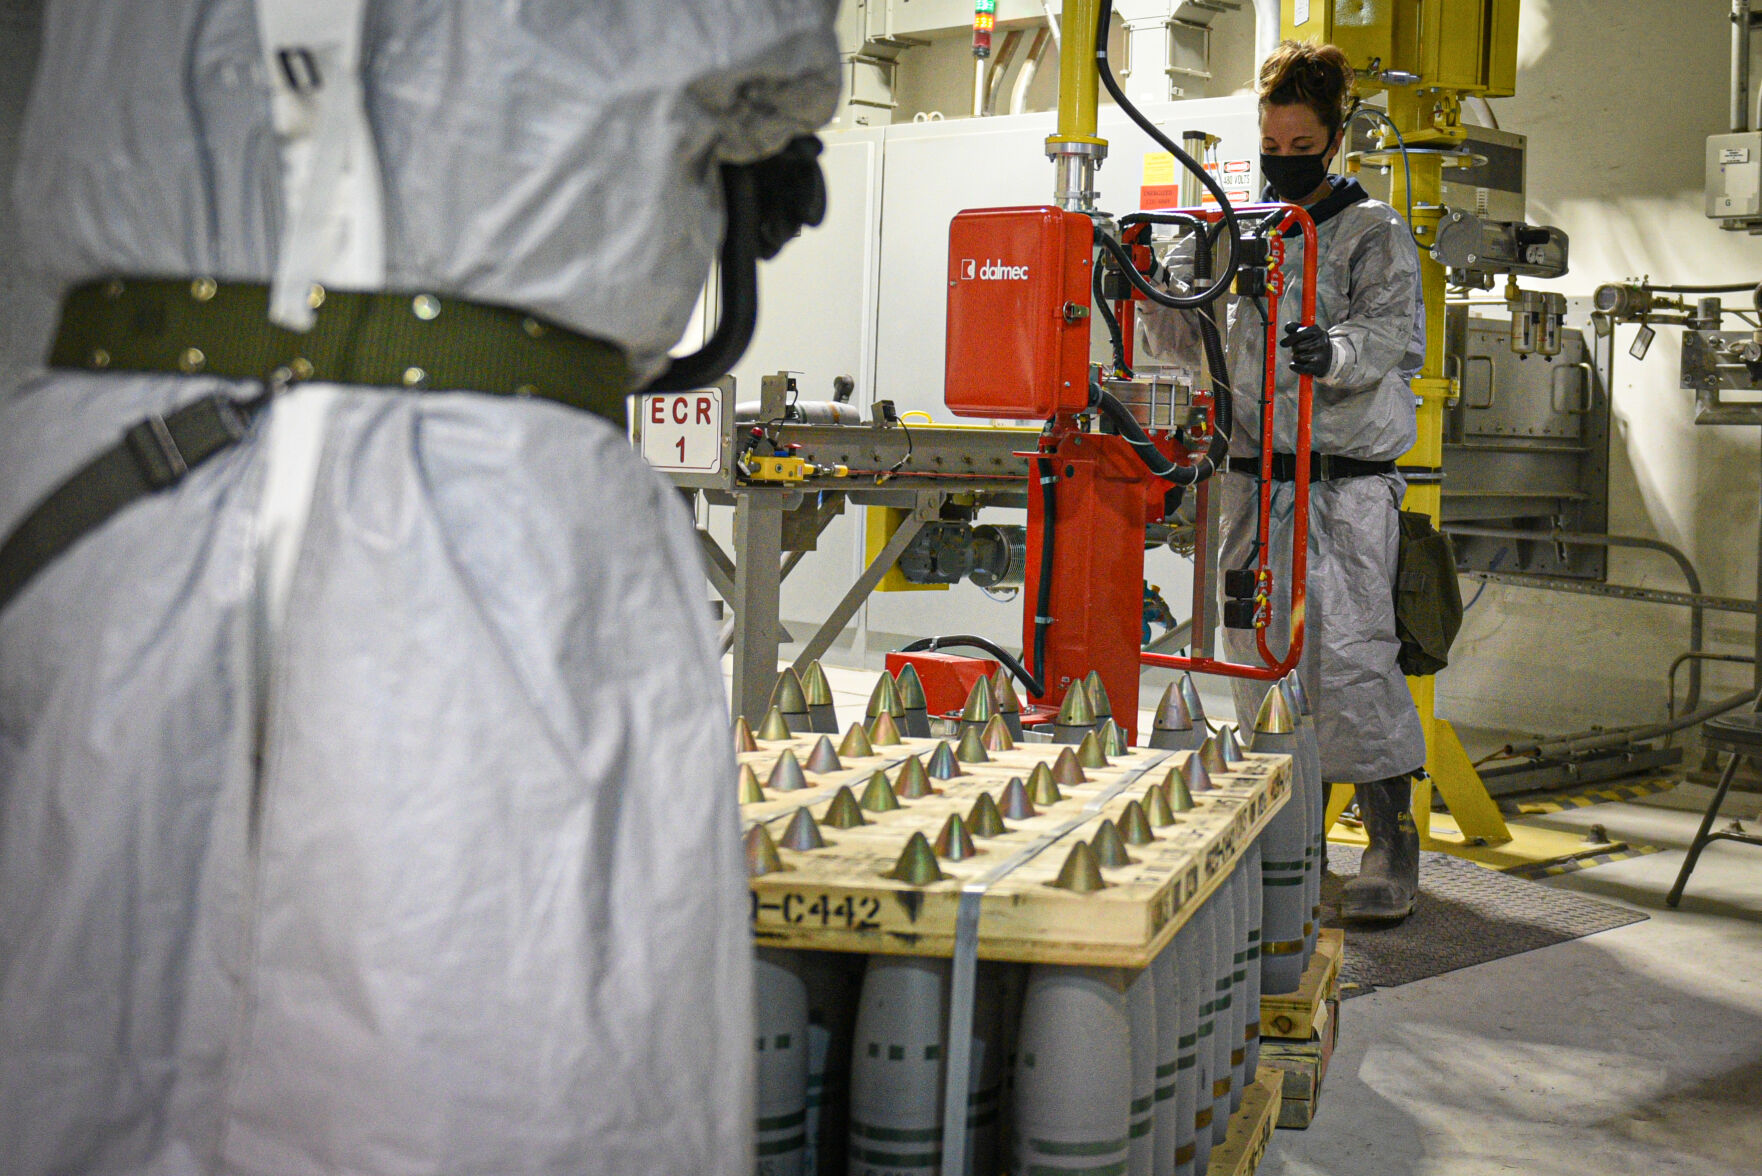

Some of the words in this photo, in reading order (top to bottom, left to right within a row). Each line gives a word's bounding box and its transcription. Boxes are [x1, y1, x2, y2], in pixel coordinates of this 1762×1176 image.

[980, 259, 1029, 280] dalmec
[651, 397, 712, 425] ECR
[676, 436, 686, 463] 1
